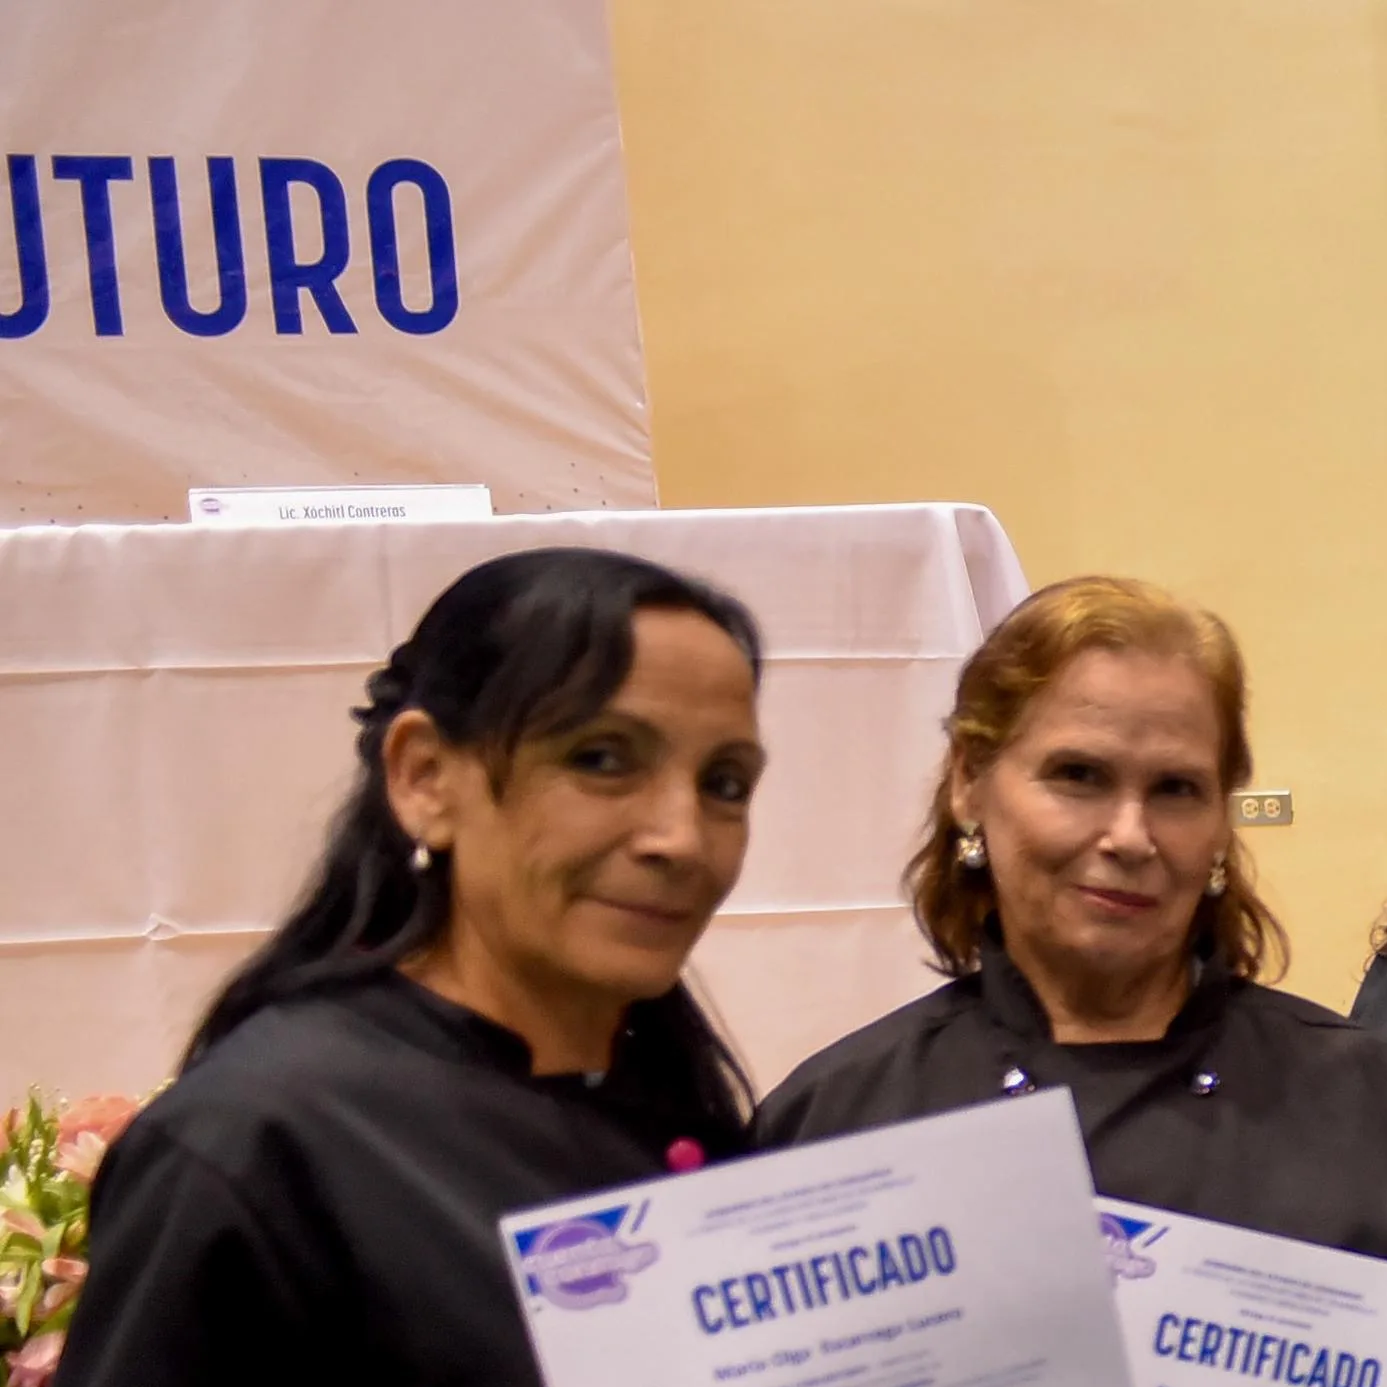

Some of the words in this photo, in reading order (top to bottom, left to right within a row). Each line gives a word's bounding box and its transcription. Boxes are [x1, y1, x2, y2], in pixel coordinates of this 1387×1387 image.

[278, 505, 299, 520] Lic.
[347, 504, 406, 519] Contreras
[691, 1226, 956, 1335] CERTIFICADO
